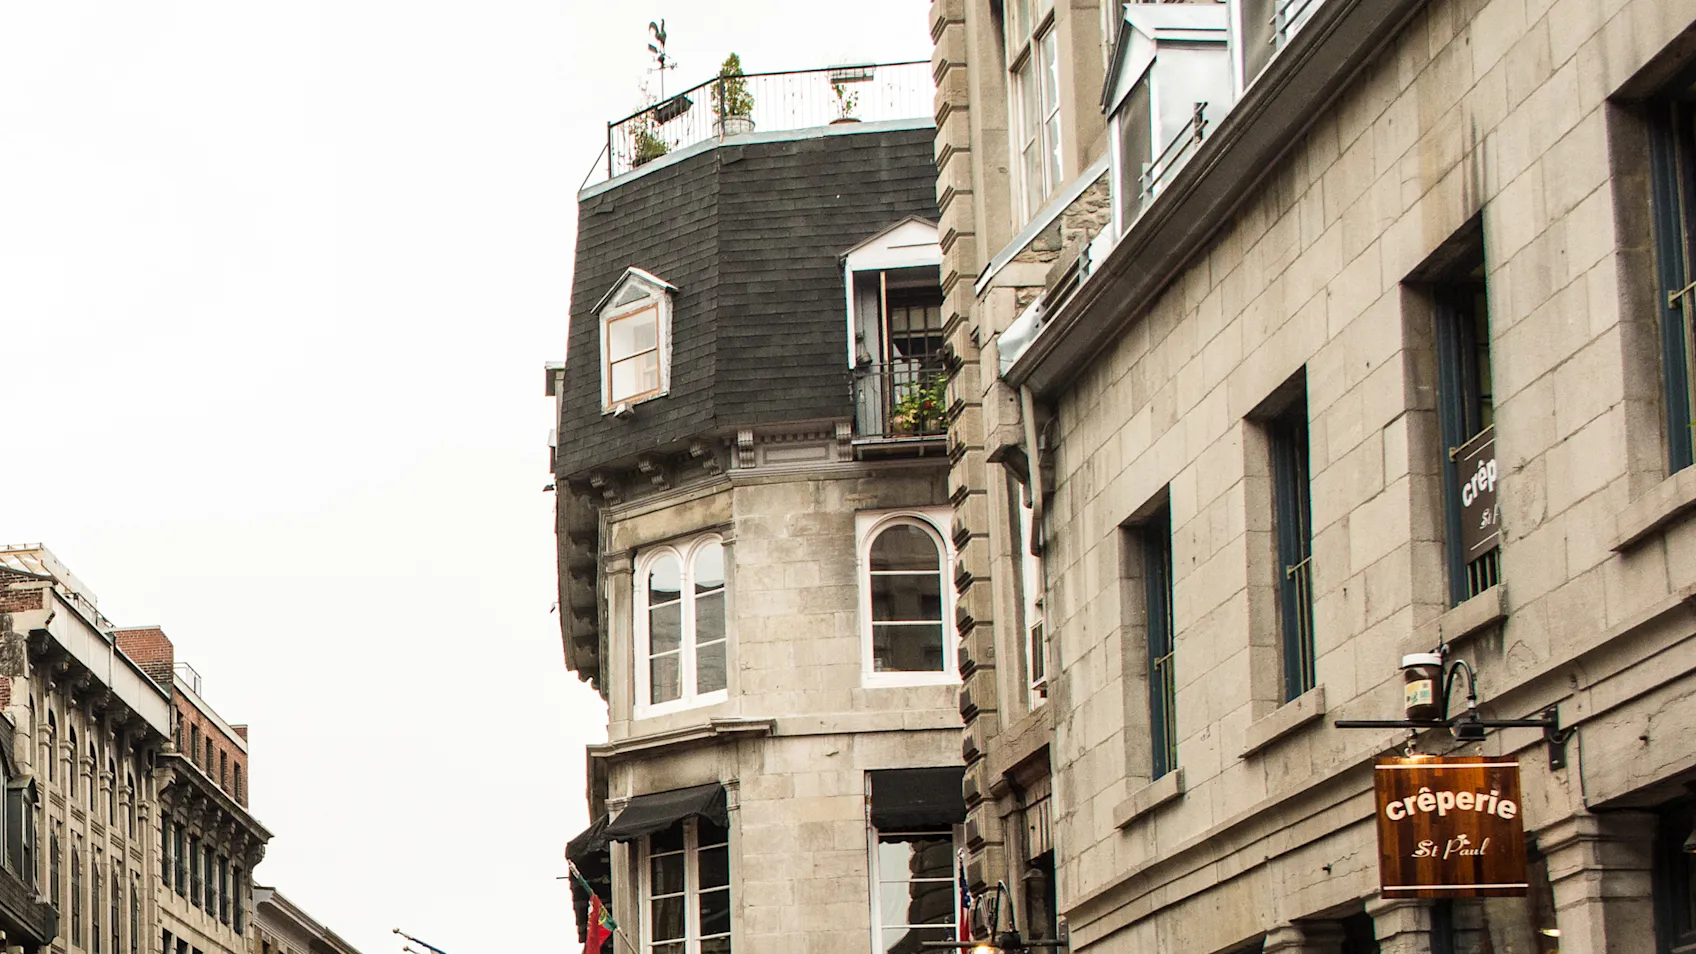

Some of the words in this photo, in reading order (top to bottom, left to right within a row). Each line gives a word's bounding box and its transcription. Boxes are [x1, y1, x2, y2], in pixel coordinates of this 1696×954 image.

[1386, 787, 1517, 820] crêperie
[1411, 839, 1439, 857] St
[1442, 835, 1491, 860] Paul
